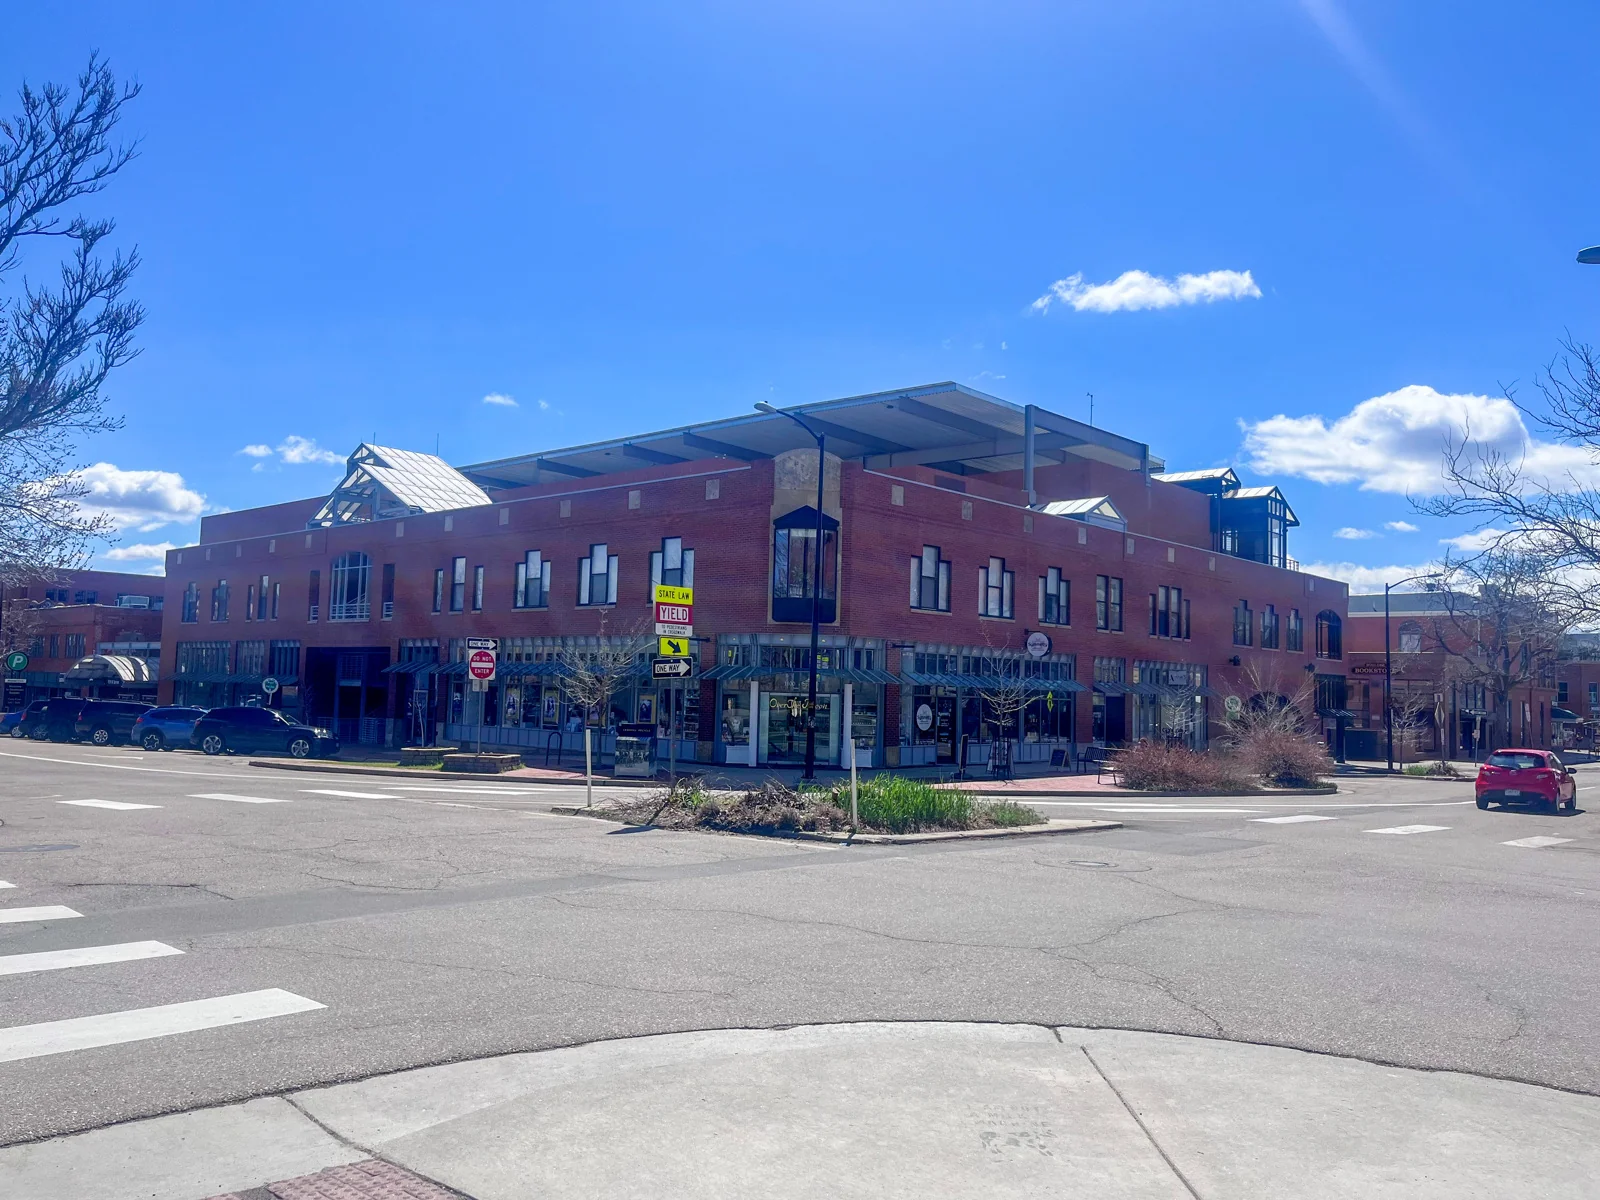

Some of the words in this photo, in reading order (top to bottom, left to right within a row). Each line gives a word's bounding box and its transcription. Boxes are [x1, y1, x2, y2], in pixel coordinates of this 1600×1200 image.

[658, 590, 675, 599] STATE
[660, 606, 688, 620] YIELD
[12, 656, 24, 668] P
